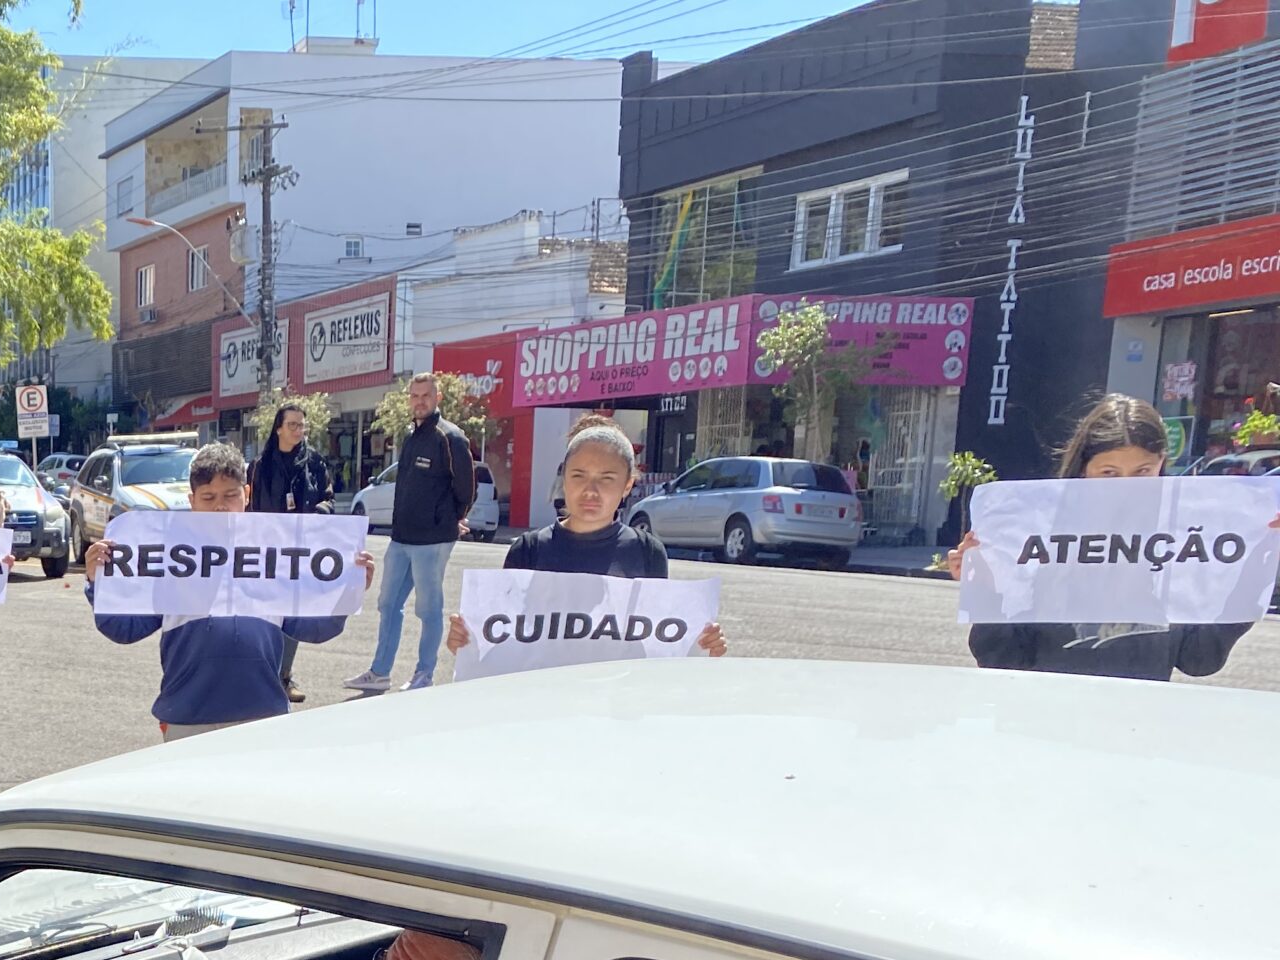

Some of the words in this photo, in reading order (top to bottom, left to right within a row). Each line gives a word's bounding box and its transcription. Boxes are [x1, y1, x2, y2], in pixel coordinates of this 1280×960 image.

[1143, 272, 1175, 292] casa
[1183, 258, 1233, 286] escola
[330, 309, 381, 344] REFLEXUS
[895, 303, 947, 325] REAL
[520, 316, 658, 378] SHOPPING
[662, 303, 741, 360] REAL
[590, 370, 610, 382] AQUI
[611, 368, 618, 380] O
[620, 365, 649, 380] PREÇO
[26, 391, 38, 408] E
[102, 543, 344, 582] RESPEITO
[1016, 525, 1247, 572] ATENÇÃO
[482, 611, 689, 643] CUIDADO
